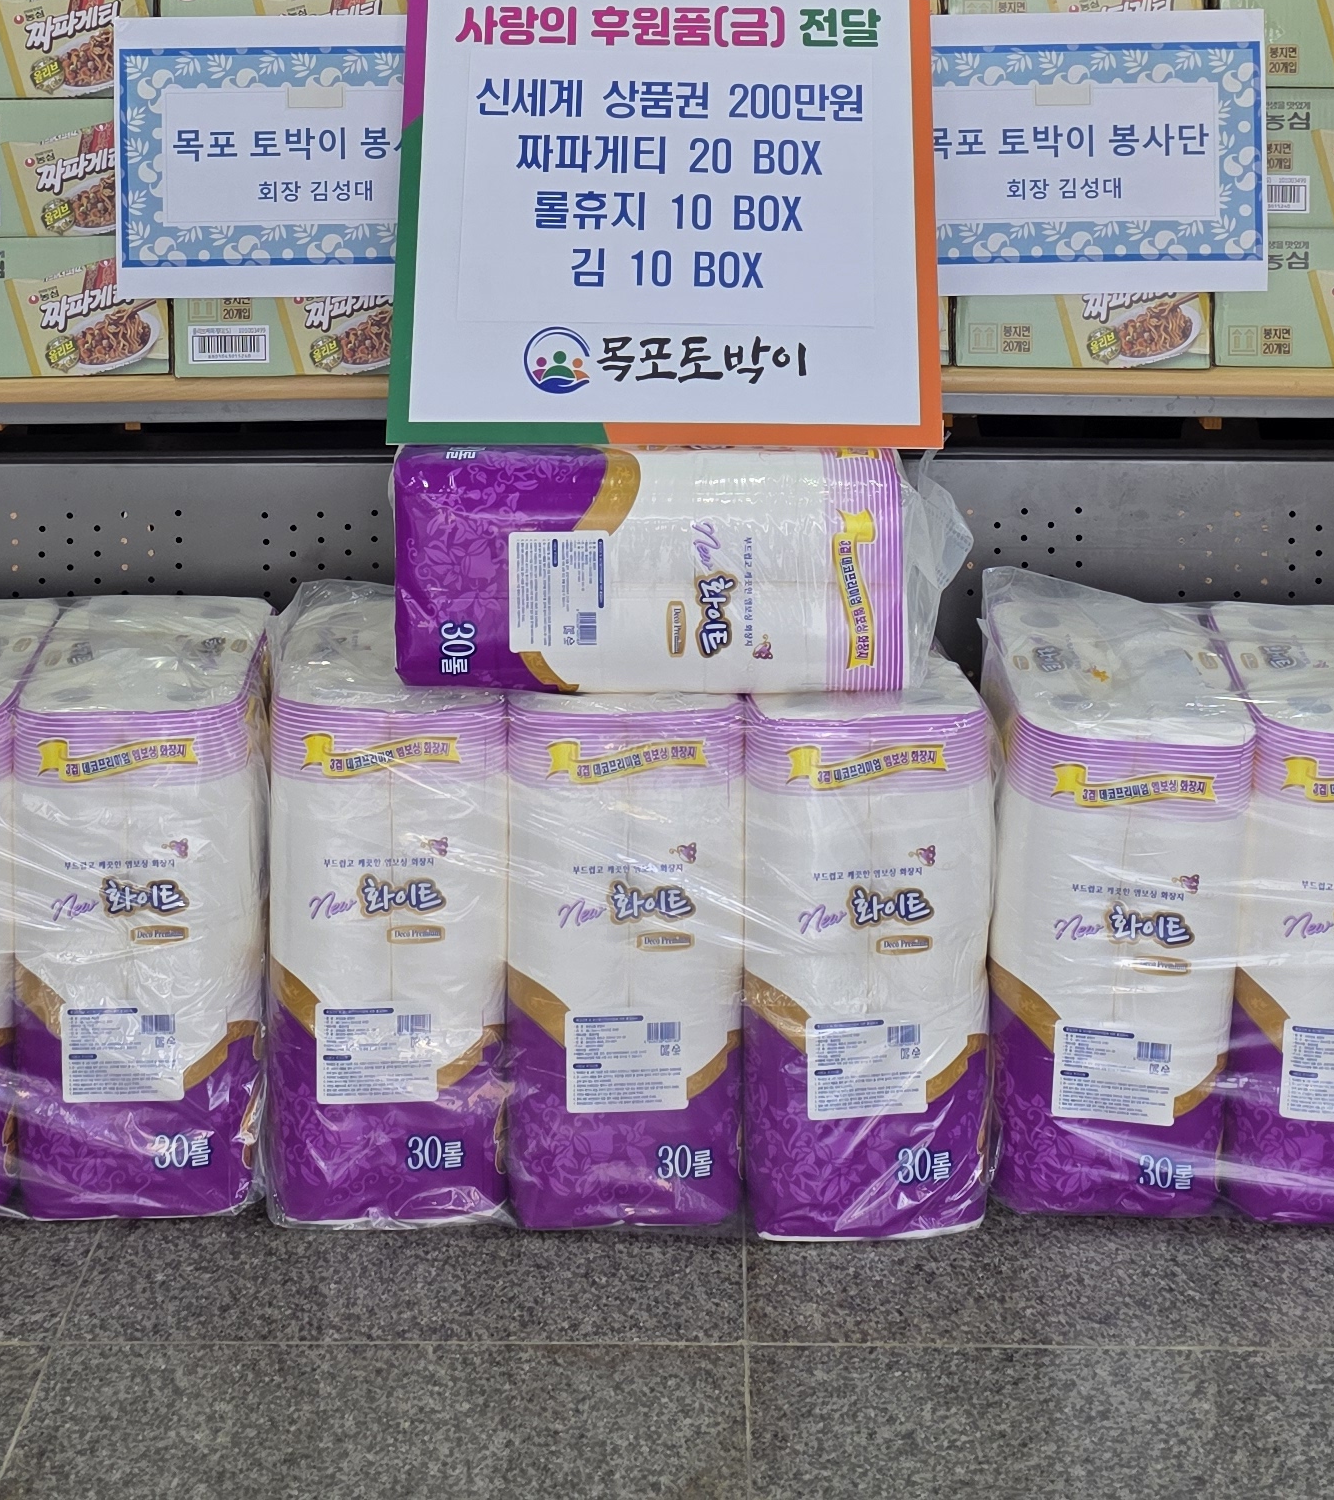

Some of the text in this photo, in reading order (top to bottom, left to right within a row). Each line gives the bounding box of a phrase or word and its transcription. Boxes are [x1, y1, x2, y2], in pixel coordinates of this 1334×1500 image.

[453, 4, 881, 49] 사랑의 후원품(금) 전달
[475, 76, 865, 123] 신세계 상품권 200만원
[172, 128, 238, 163] 목포
[249, 126, 346, 161] 토박이
[515, 133, 824, 176] 짜파게티 20 BOX
[998, 124, 1095, 158] 토박이
[1108, 123, 1210, 158] 봉사단
[257, 179, 374, 203] 회장 김성대
[1006, 176, 1123, 201] 회장 김성대
[533, 190, 804, 233] 롤휴지 10 BOX
[570, 247, 765, 290] 김 10 BOX
[595, 336, 808, 385] 목포토박이
[361, 874, 445, 914] 화이트
[853, 887, 933, 926] 화이트
[406, 1135, 466, 1172] 30롤
[895, 1145, 953, 1184] 30롤
